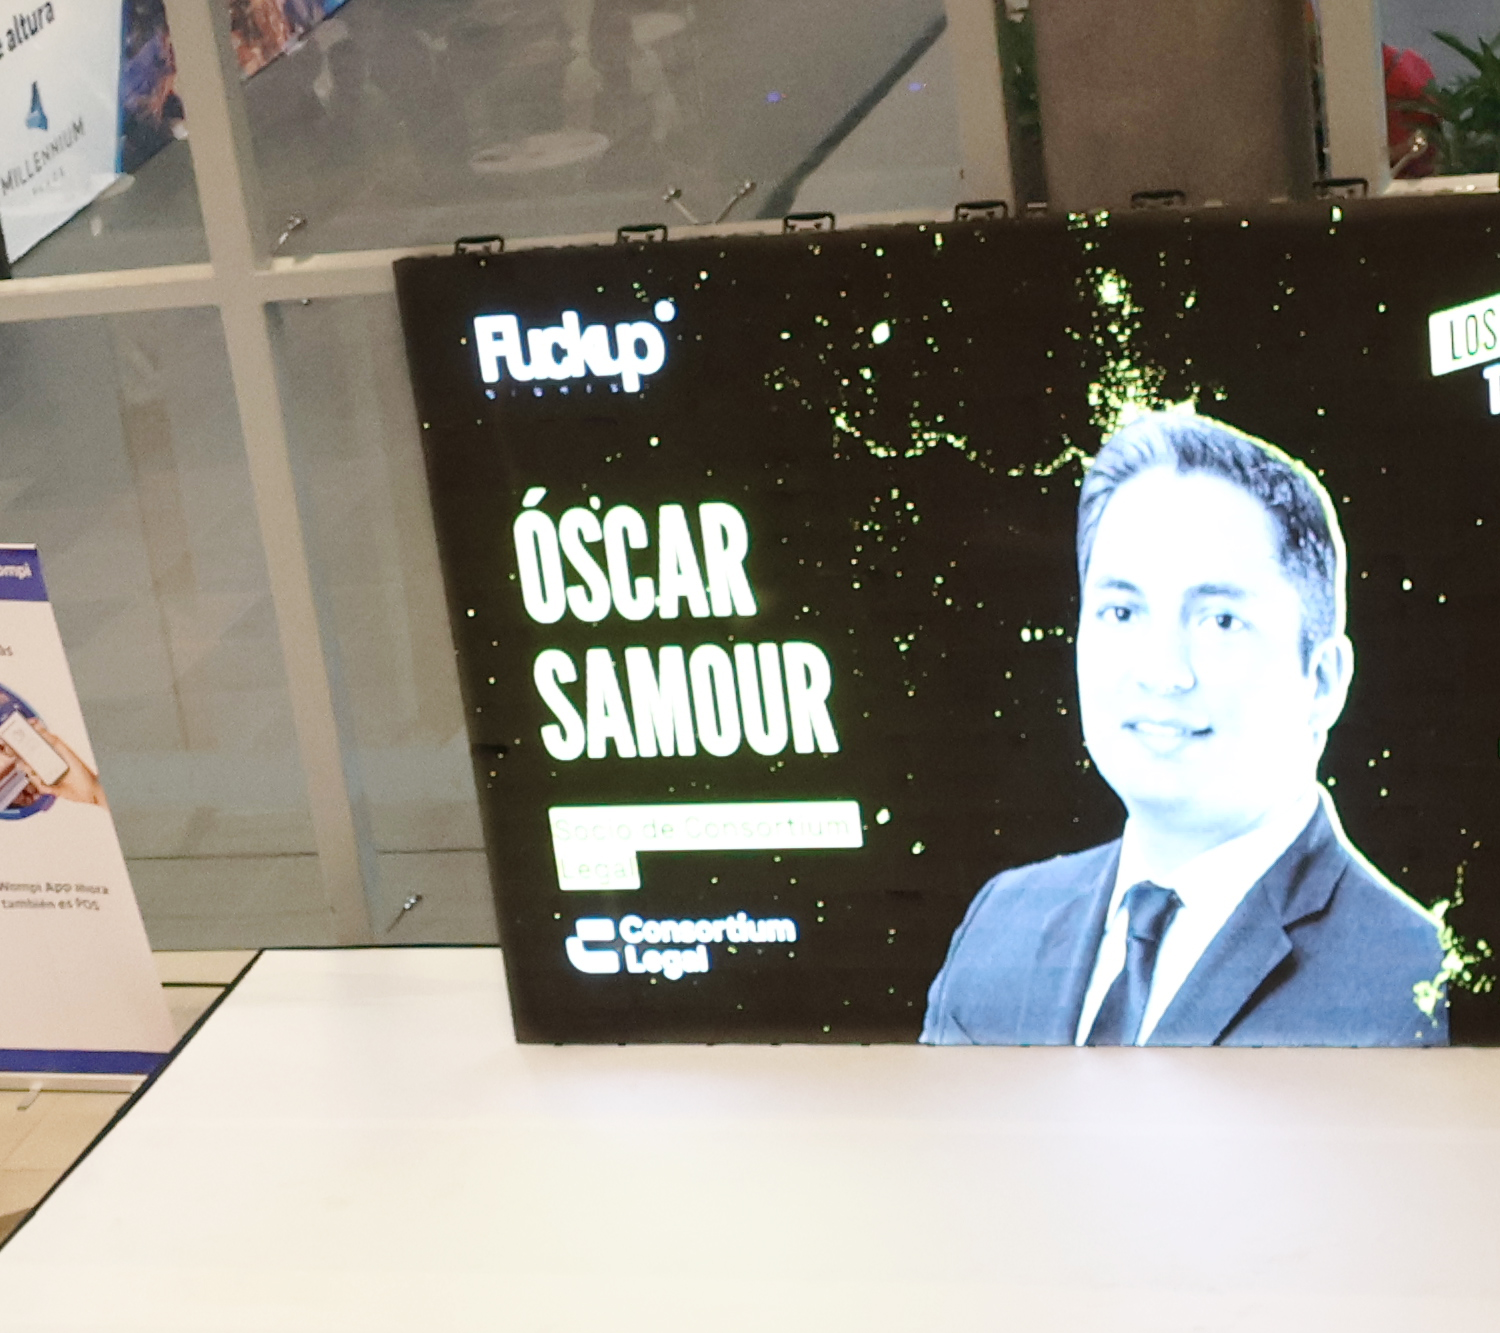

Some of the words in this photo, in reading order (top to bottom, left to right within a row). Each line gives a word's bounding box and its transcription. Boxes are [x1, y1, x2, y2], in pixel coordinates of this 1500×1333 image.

[7, 2, 55, 52] altura
[0, 117, 86, 197] MILLENNIUM
[1449, 309, 1497, 361] LOS
[513, 486, 758, 624] ÓSCAR
[533, 641, 840, 761] SAMOUR
[555, 819, 632, 842] Socio
[642, 819, 675, 840] de
[684, 816, 850, 840] Consortium
[560, 856, 637, 886] Legal
[619, 911, 797, 944] Consortium
[624, 944, 709, 980] Legal
